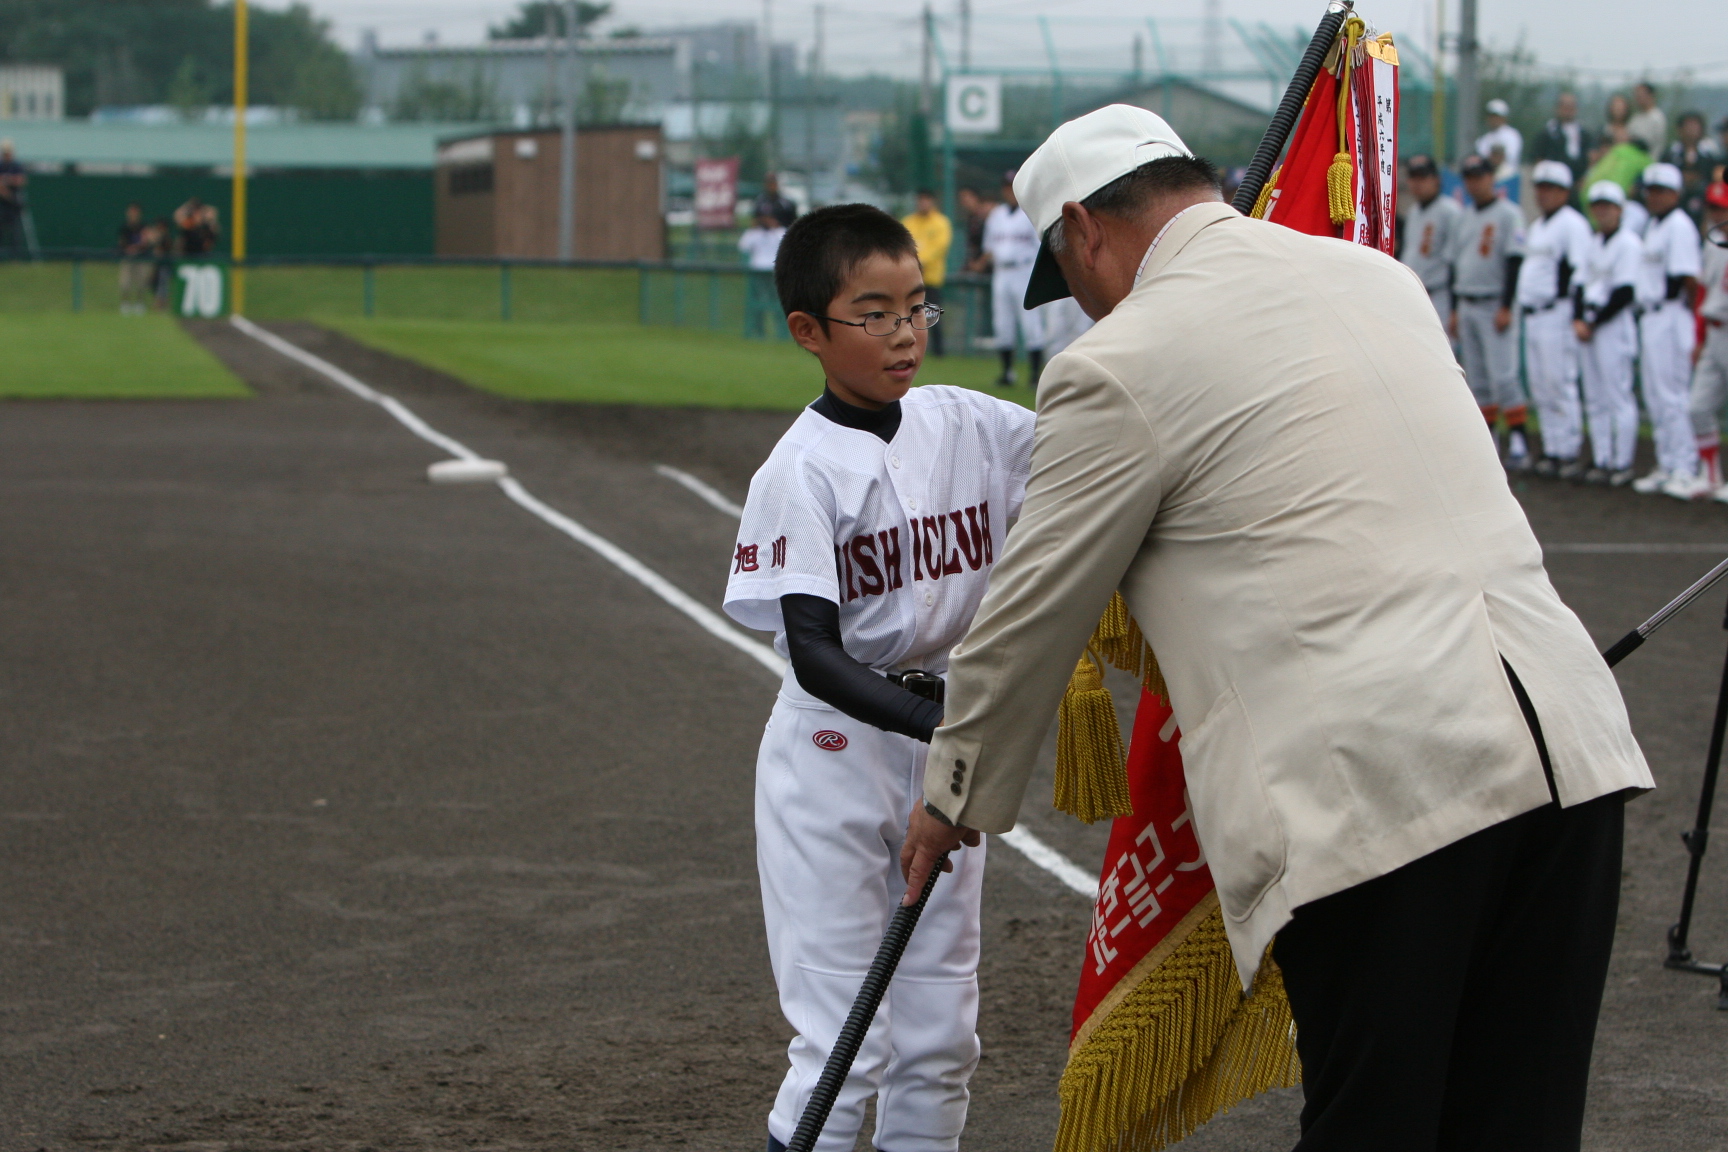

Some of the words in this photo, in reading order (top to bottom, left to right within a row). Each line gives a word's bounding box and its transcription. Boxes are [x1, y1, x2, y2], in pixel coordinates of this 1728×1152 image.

[958, 84, 987, 119] C
[176, 264, 223, 317] 70
[732, 535, 787, 575] 旭川
[1093, 872, 1175, 977] パーラー
